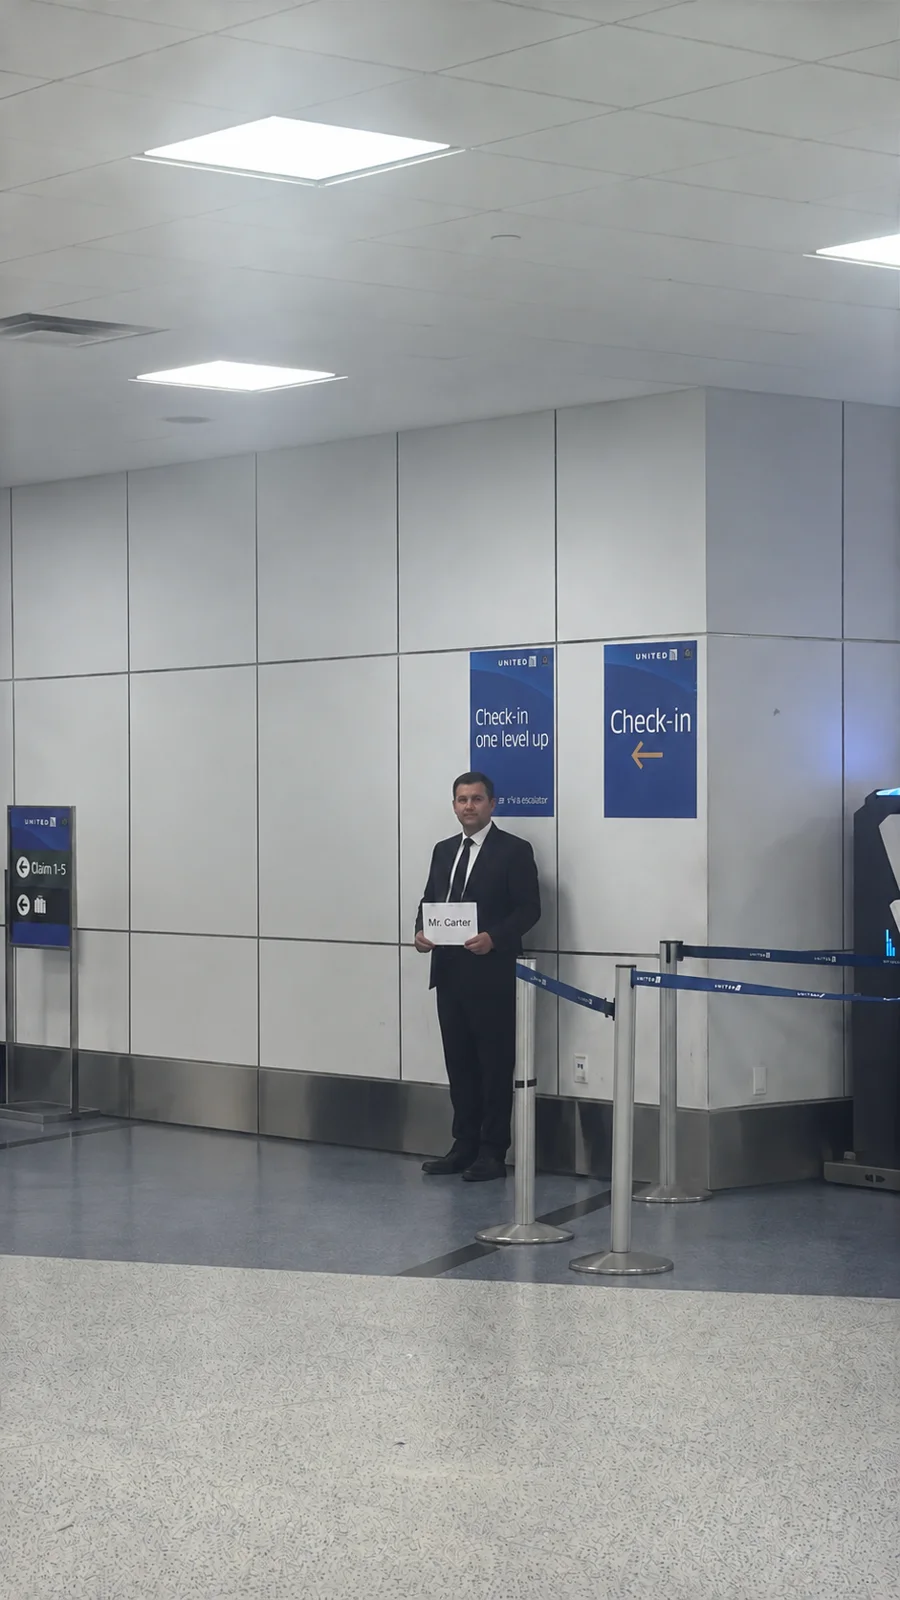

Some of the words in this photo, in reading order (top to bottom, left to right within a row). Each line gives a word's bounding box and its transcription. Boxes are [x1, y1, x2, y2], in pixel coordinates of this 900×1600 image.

[635, 651, 667, 660] UNITED
[498, 658, 527, 667] UNITED
[475, 706, 528, 726] Check-in
[610, 707, 691, 734] Check-in
[475, 734, 498, 748] one
[501, 730, 529, 748] level
[532, 733, 549, 750] up
[24, 818, 49, 826] UNITED
[31, 861, 52, 875] Claim
[53, 863, 66, 876] 1-5
[428, 918, 442, 927] Mr.
[444, 918, 471, 927] Carter
